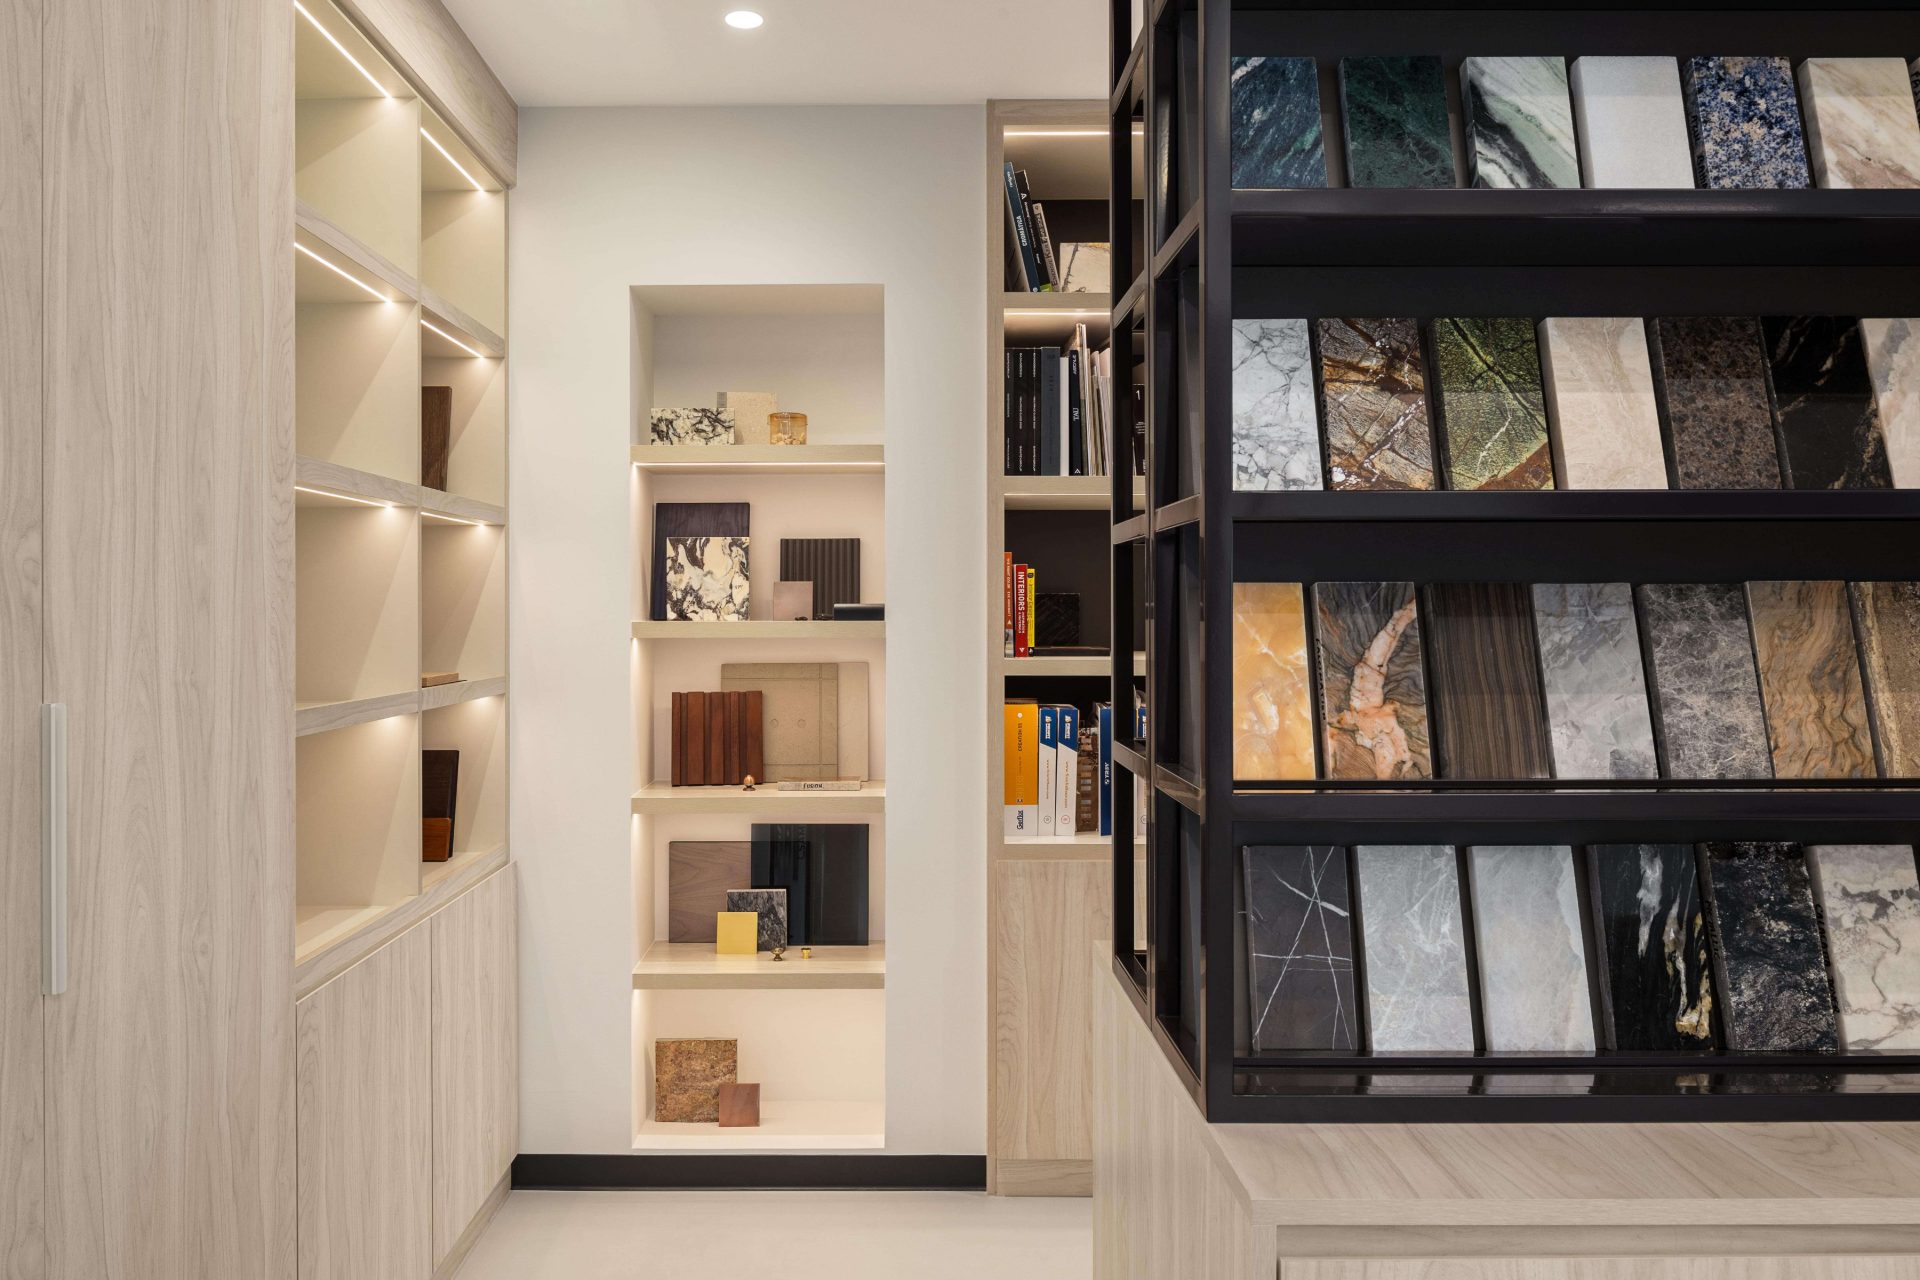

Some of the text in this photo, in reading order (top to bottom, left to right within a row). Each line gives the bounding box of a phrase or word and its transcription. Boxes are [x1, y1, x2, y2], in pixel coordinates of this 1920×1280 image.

[1072, 407, 1080, 422] TAU
[1017, 571, 1025, 611] INTERIORS
[1016, 810, 1024, 830] Gerflor
